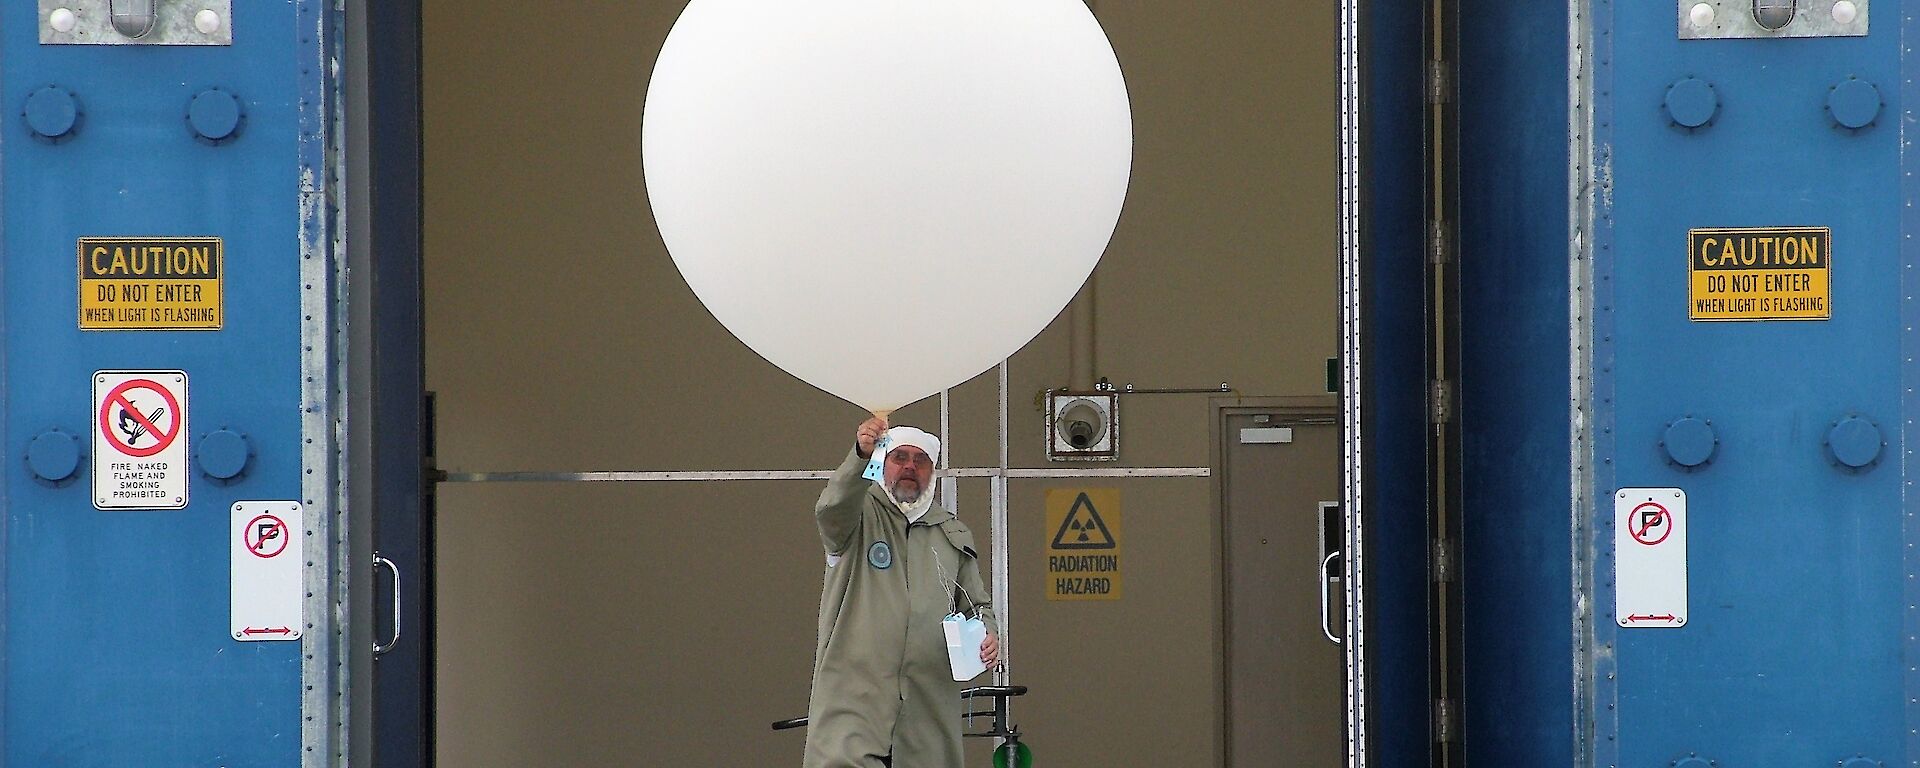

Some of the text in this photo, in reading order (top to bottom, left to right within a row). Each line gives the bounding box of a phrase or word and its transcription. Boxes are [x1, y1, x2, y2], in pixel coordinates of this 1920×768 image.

[1701, 236, 1818, 266] CAUTION
[91, 246, 210, 275] CAUTION
[1708, 273, 1810, 293] DO NOT ENTER
[98, 284, 202, 302] DO NOT ENTER
[1696, 297, 1823, 313] WHEN LIGHT IS FLASHING
[85, 307, 214, 322] WHEN LIGHT IS FLASHING
[137, 462, 168, 470] NAKED
[113, 472, 144, 480] FLAME
[120, 481, 160, 489] SMOKING
[113, 490, 166, 498] PROHIBITED
[1641, 511, 1663, 537] P
[258, 523, 280, 550] P
[1049, 554, 1117, 572] RADIATION
[1056, 577, 1111, 595] HAZARD
